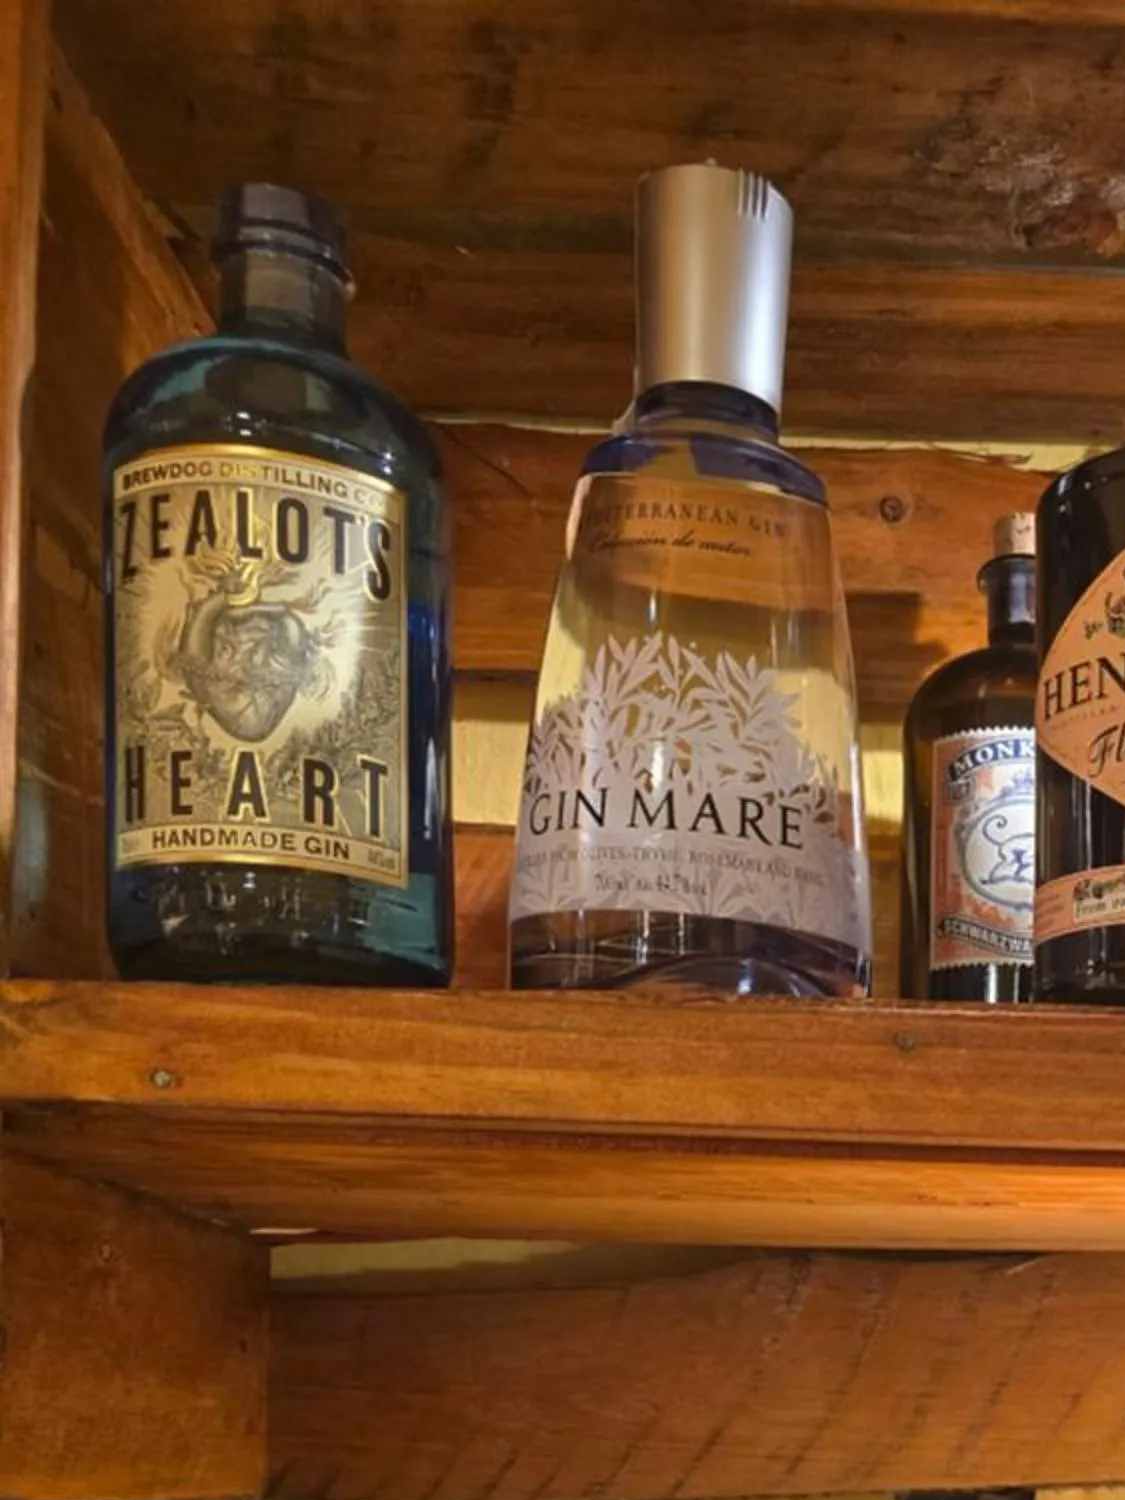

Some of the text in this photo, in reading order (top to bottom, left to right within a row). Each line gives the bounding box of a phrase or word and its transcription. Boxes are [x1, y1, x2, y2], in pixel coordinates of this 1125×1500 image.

[122, 460, 213, 490] BREWDOG
[124, 744, 389, 838] HEART
[528, 787, 804, 850] GIN MARE
[152, 827, 298, 851] HANDMADE
[304, 835, 350, 860] GIN
